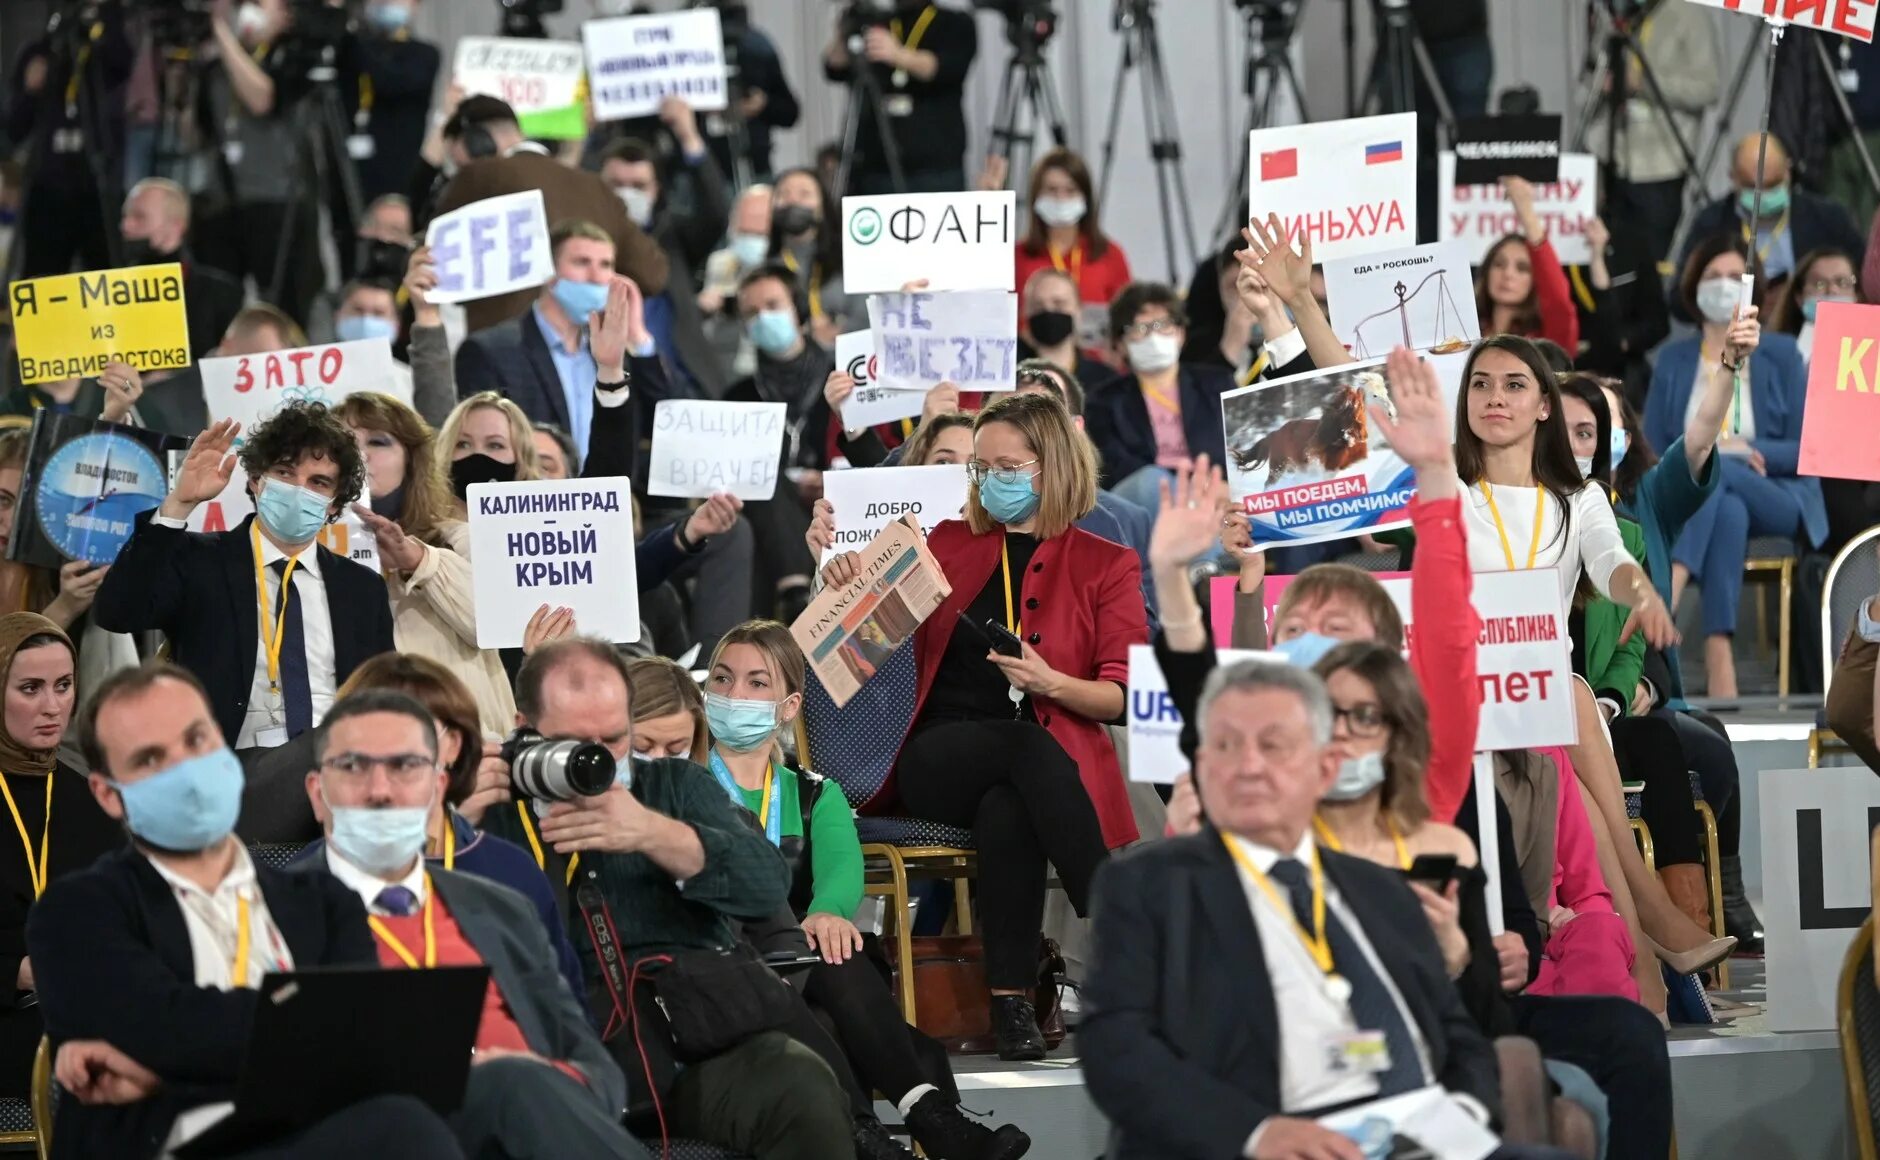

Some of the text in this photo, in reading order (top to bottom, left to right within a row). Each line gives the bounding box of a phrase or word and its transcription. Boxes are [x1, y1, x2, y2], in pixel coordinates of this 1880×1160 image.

[1723, 0, 1876, 39] ИЕ
[890, 204, 1008, 244] ФАН
[1263, 199, 1405, 246] ИНЬХУА
[429, 209, 533, 293] EFE
[1353, 265, 1373, 275] ЕДА
[1382, 255, 1434, 270] РОСКОШЬ?
[14, 283, 37, 317] Я
[79, 274, 180, 309] Маша
[880, 294, 934, 330] НЕ
[91, 324, 115, 340] из
[20, 348, 187, 380] Владивостока
[233, 348, 343, 393] ЗАТО
[882, 333, 1016, 382] ВЕЗЕТ
[657, 404, 780, 438] ЗАЩИТА
[74, 462, 139, 485] ВЛАДОСТОК
[669, 453, 777, 488] ВРАЧЕЙ
[479, 491, 620, 515] КАЛИНИНГРАД
[865, 501, 923, 519] ДОБРО
[1247, 480, 1367, 513] МЫ ПОЕДЕМ,
[1279, 509, 1314, 527] МЫ
[507, 523, 597, 557] НОВЫЙ
[515, 560, 593, 587] КРЫМ
[808, 576, 868, 640] FINANCIAL
[866, 538, 903, 581] TIMES
[1477, 614, 1559, 646] СПУБЛИКА
[1478, 670, 1553, 705] лет
[1133, 689, 1179, 722] UR
[592, 913, 612, 945] EOS
